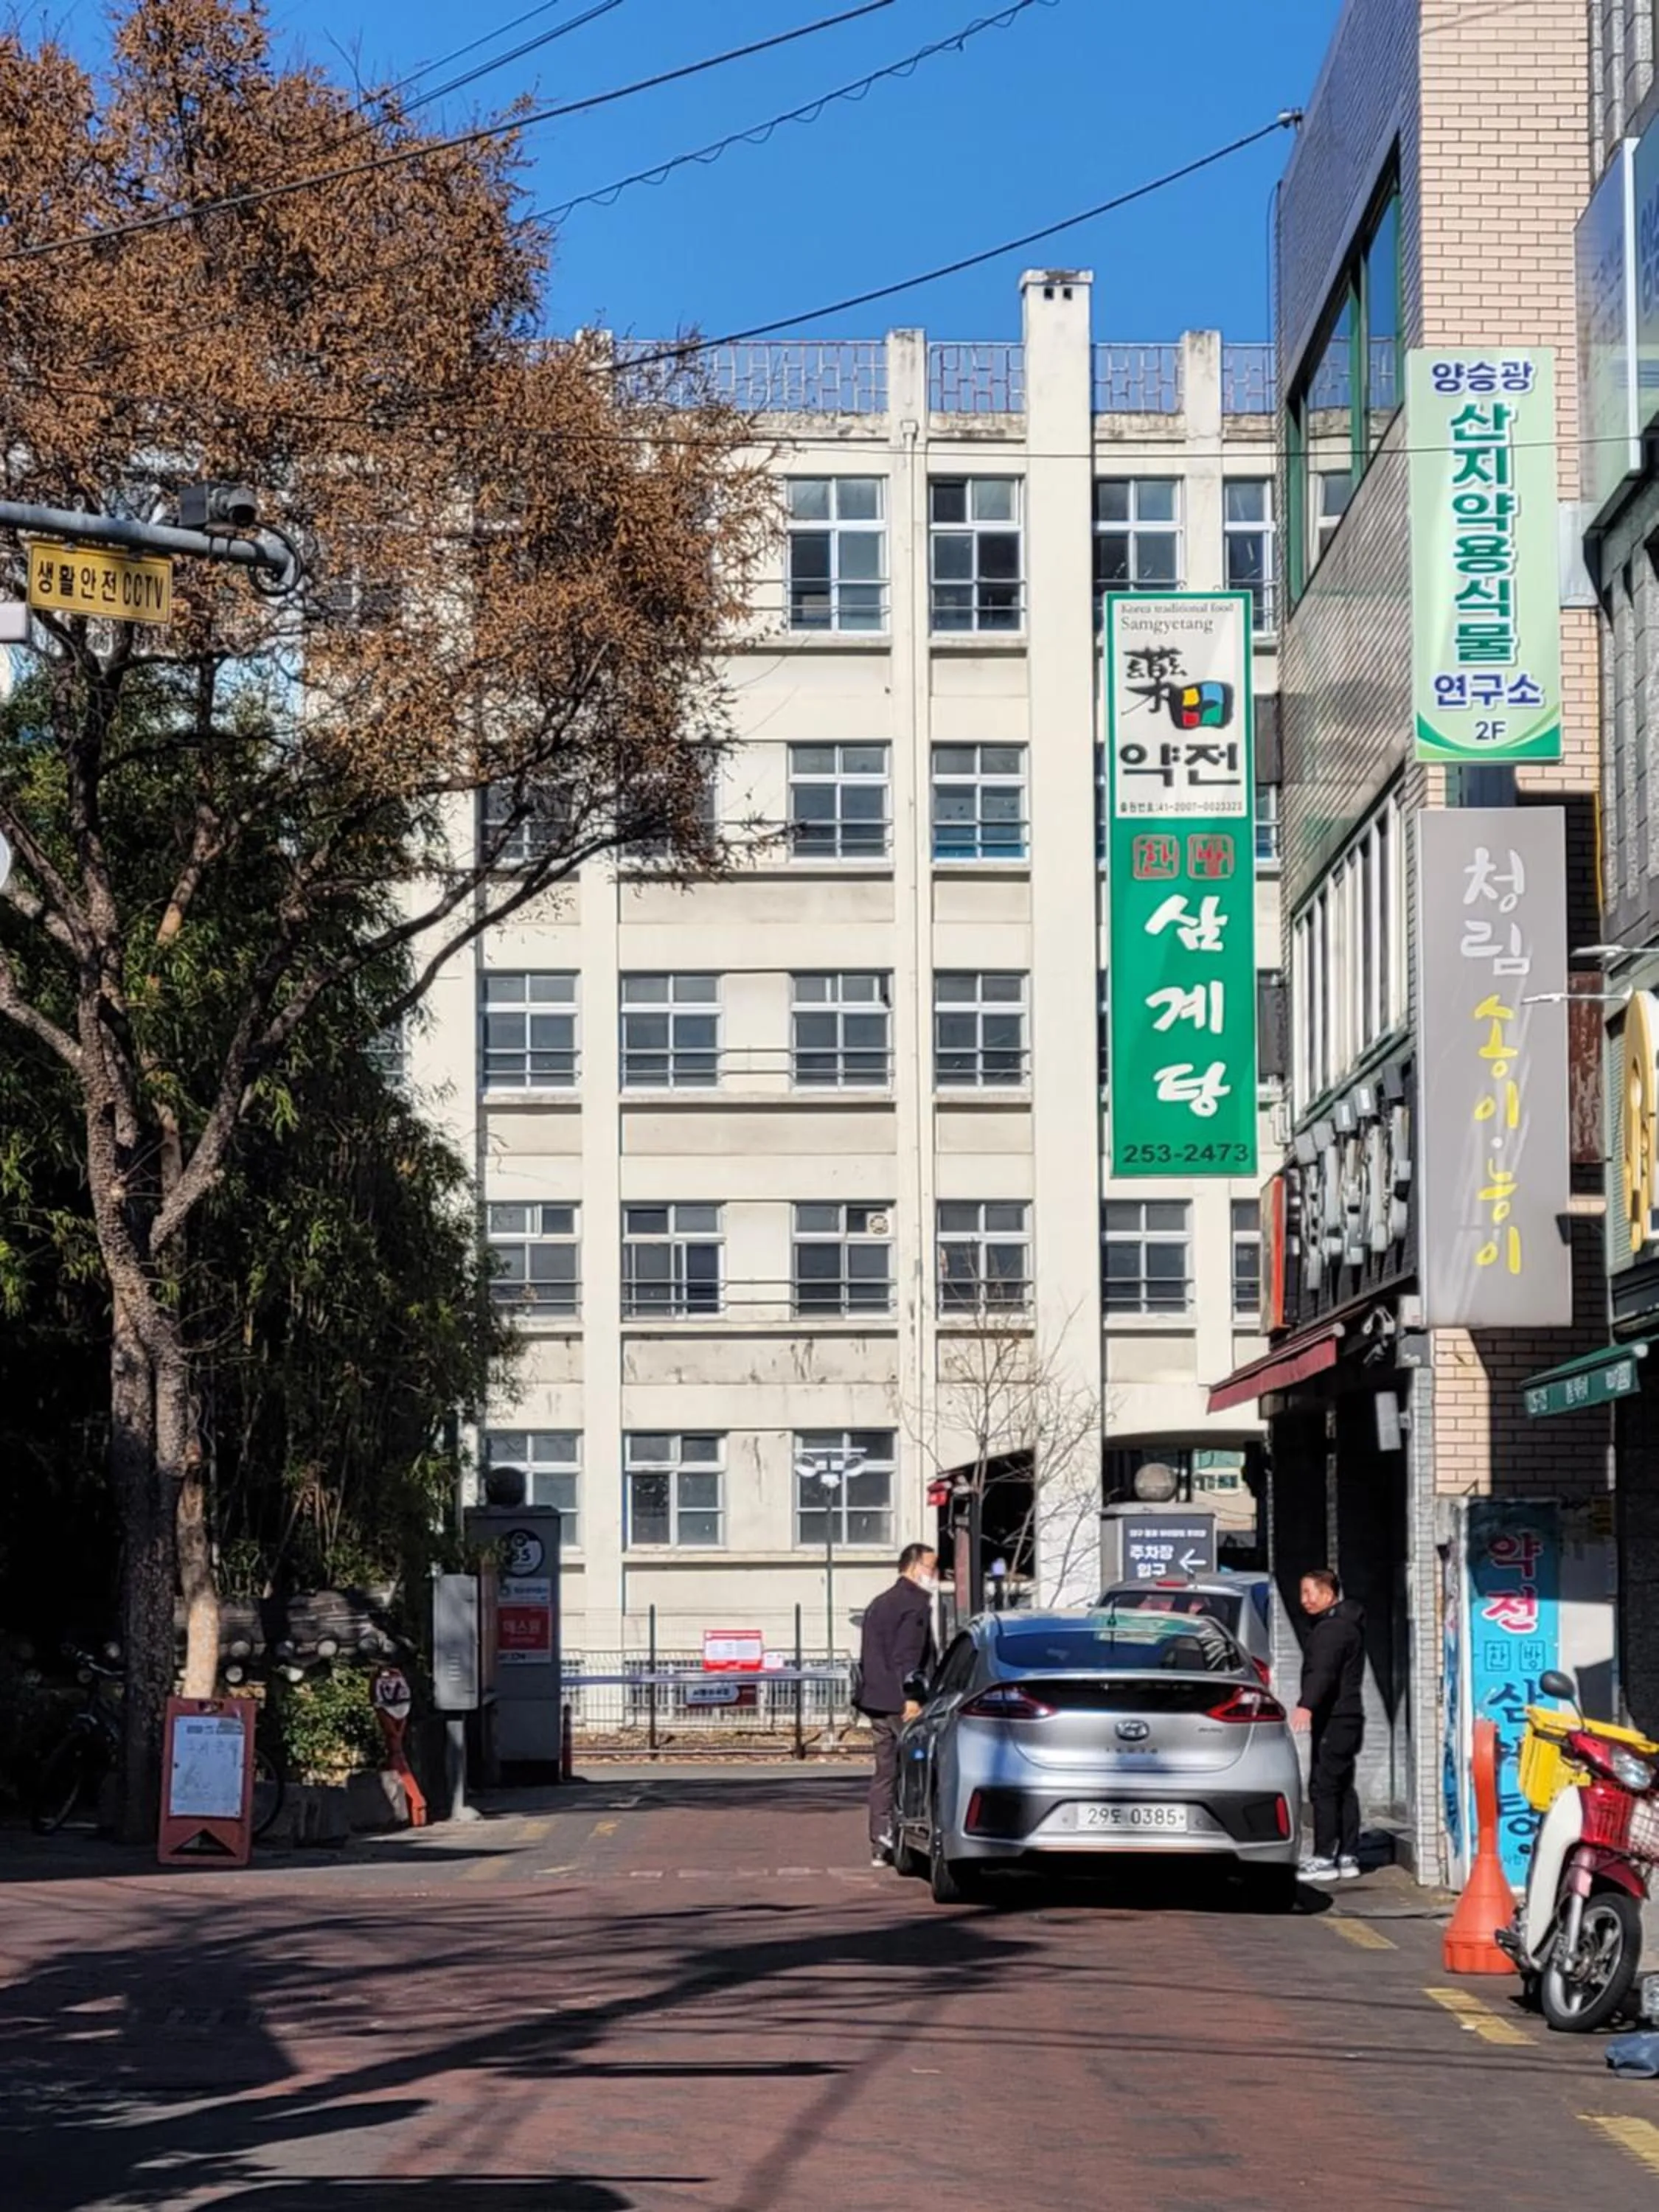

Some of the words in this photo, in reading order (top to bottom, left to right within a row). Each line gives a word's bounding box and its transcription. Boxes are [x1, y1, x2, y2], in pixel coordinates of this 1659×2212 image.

[1432, 362, 1532, 392] 양승광
[1211, 603, 1234, 613] food
[1434, 674, 1543, 707] 연구소
[1475, 720, 1506, 740] 2F
[1120, 742, 1241, 787] 약전
[1460, 846, 1531, 975] 청림
[1145, 894, 1231, 1117] 삼계탕
[1123, 1144, 1248, 1163] 253-2473
[1130, 1544, 1174, 1561] 주차장
[1136, 1562, 1166, 1579] 입구
[1482, 1531, 1543, 1633] 약전
[1130, 1809, 1177, 1825] 0385
